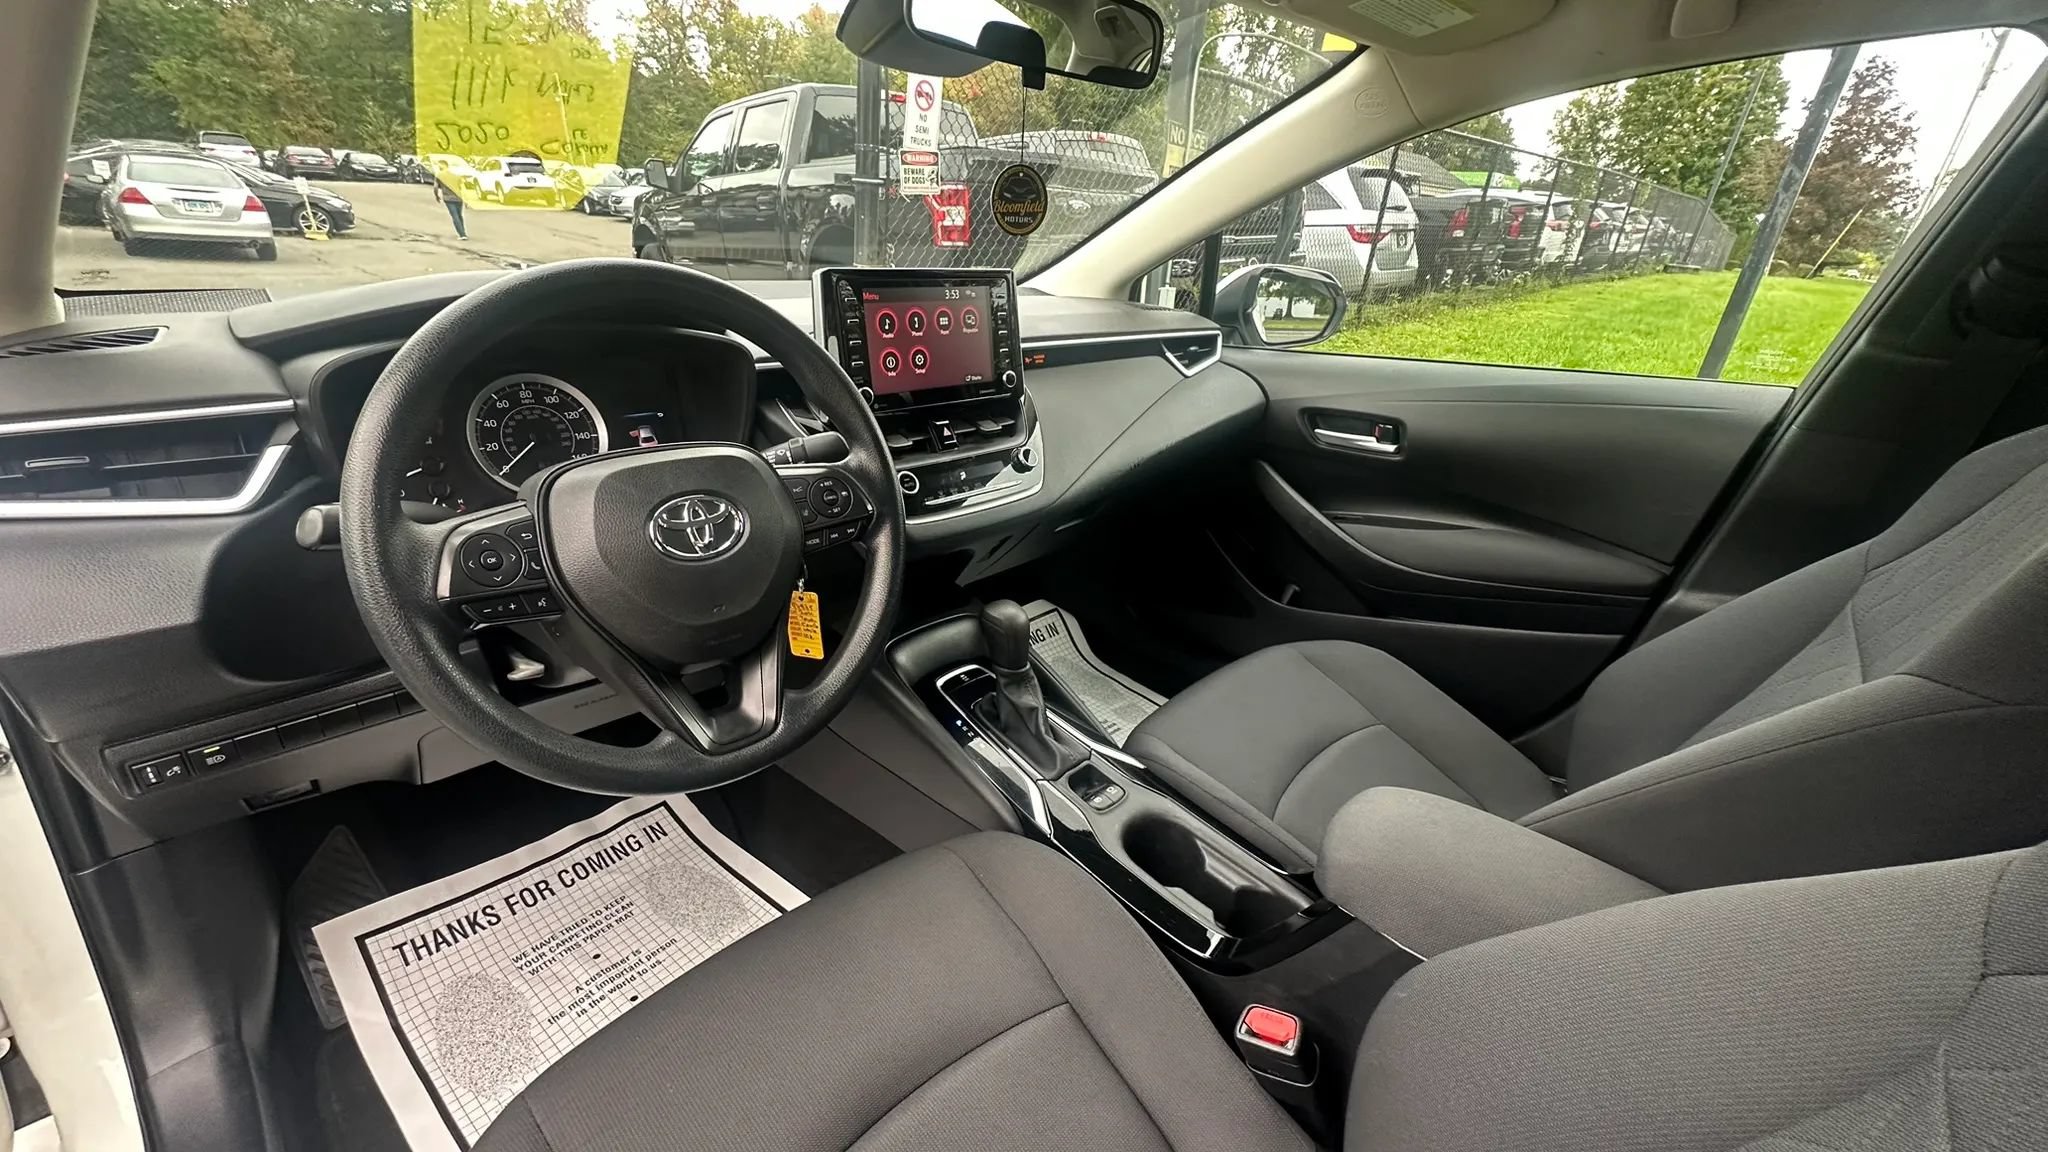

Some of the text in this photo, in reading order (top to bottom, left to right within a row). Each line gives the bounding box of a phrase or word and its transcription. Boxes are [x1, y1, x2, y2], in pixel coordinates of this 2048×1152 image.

[919, 113, 927, 123] NO
[915, 125, 929, 134] SEMI
[910, 137, 931, 147] TRUCKS
[1170, 125, 1205, 150] NOCE
[903, 167, 925, 176] BEWARE
[903, 176, 926, 185] OF DOGS
[993, 198, 1046, 216] Bloomfield
[1004, 215, 1033, 224] MOTORS
[863, 289, 960, 300] Menu 3:53
[519, 390, 532, 398] 80
[496, 400, 509, 408] 60
[544, 396, 560, 404] 100
[564, 411, 580, 419] 120
[483, 420, 497, 428] 40
[486, 443, 499, 451] 20
[1045, 622, 1059, 638] IN
[392, 821, 669, 967] THANKS FOR COMING IN
[512, 895, 627, 964] WE HAVE TRIED TO KEEP
[517, 901, 634, 972] YOUR CARPETING CLEAN
[528, 910, 636, 977] WITH THIS PAPER MAT
[575, 949, 642, 994] A customer is
[548, 937, 678, 1025] the most important person
[576, 1007, 588, 1018] in
[589, 994, 606, 1009] the
[608, 975, 637, 995] world
[637, 968, 648, 977] to
